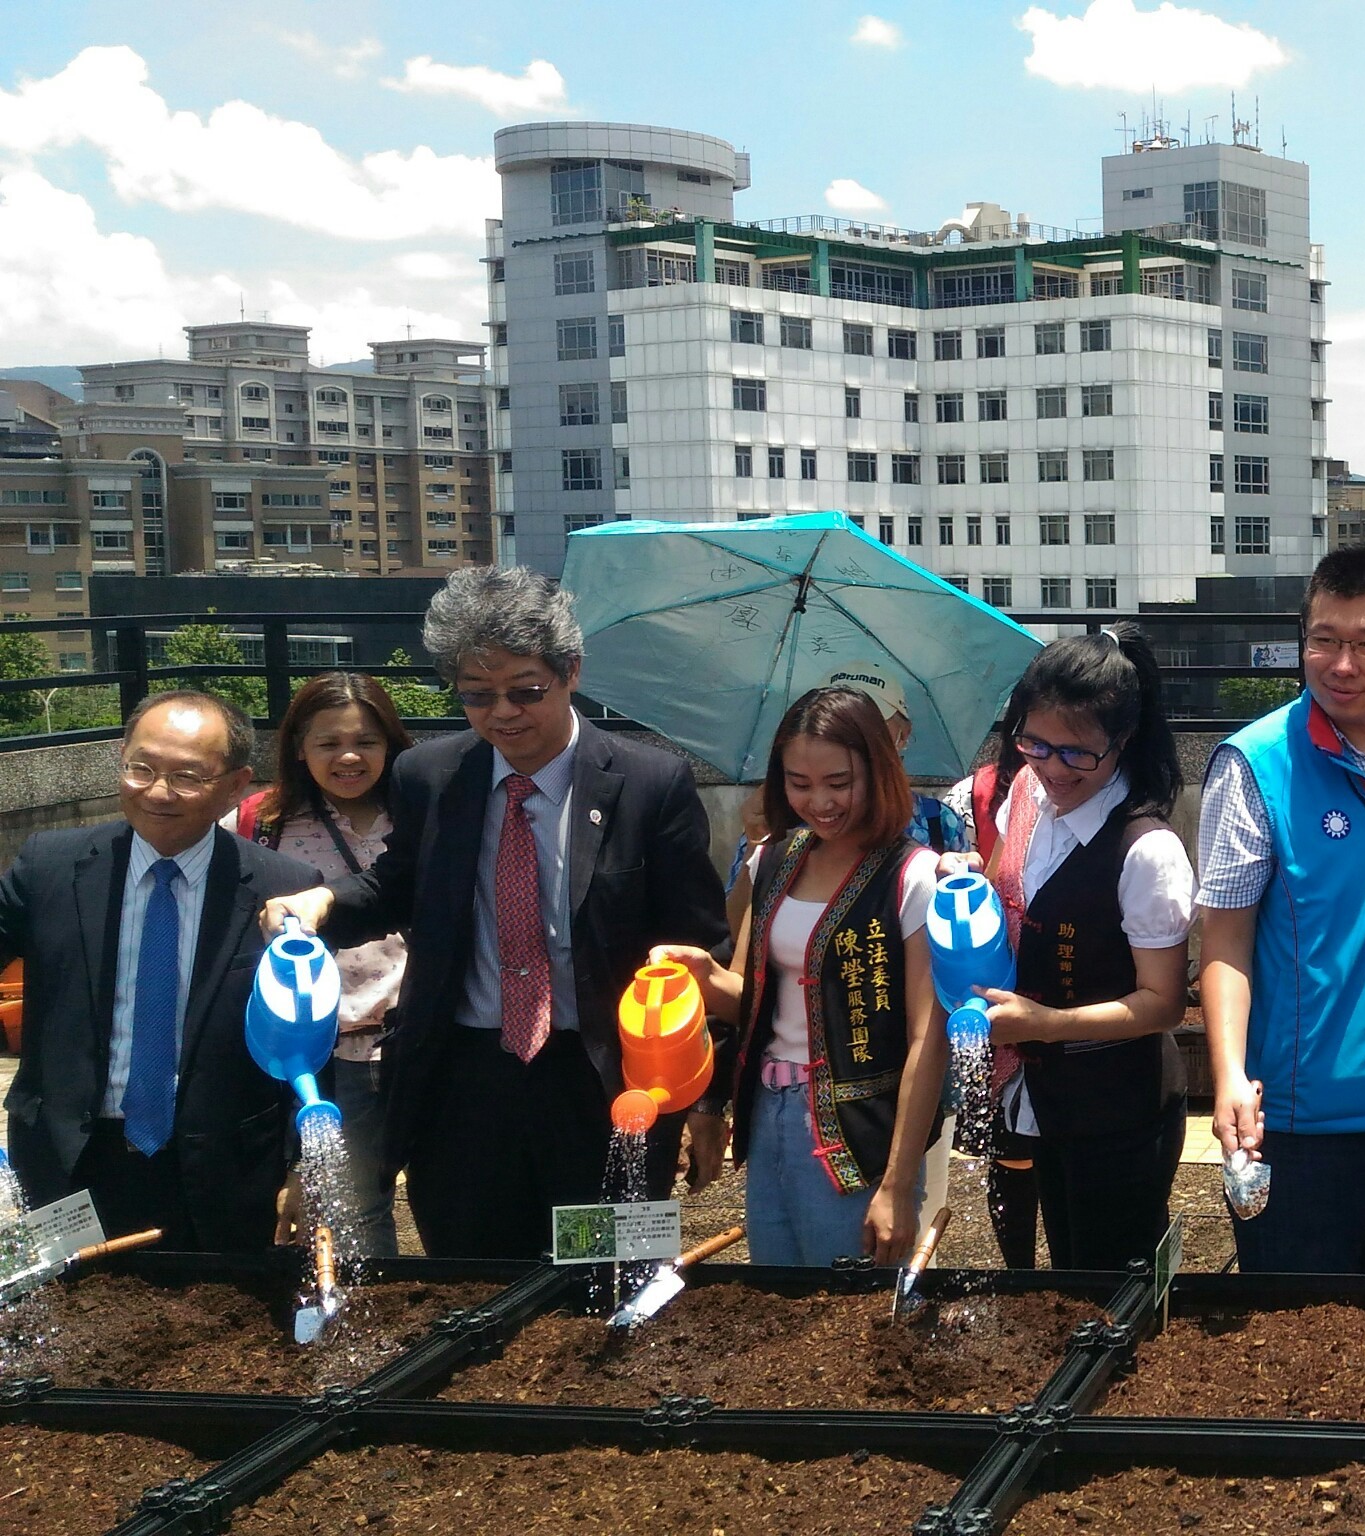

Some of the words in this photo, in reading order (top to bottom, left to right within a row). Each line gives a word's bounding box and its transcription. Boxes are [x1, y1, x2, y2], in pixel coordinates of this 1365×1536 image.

[830, 671, 886, 689] maruman
[834, 928, 873, 1063] 陳瑩服務團隊
[866, 918, 891, 1011] 立法委員
